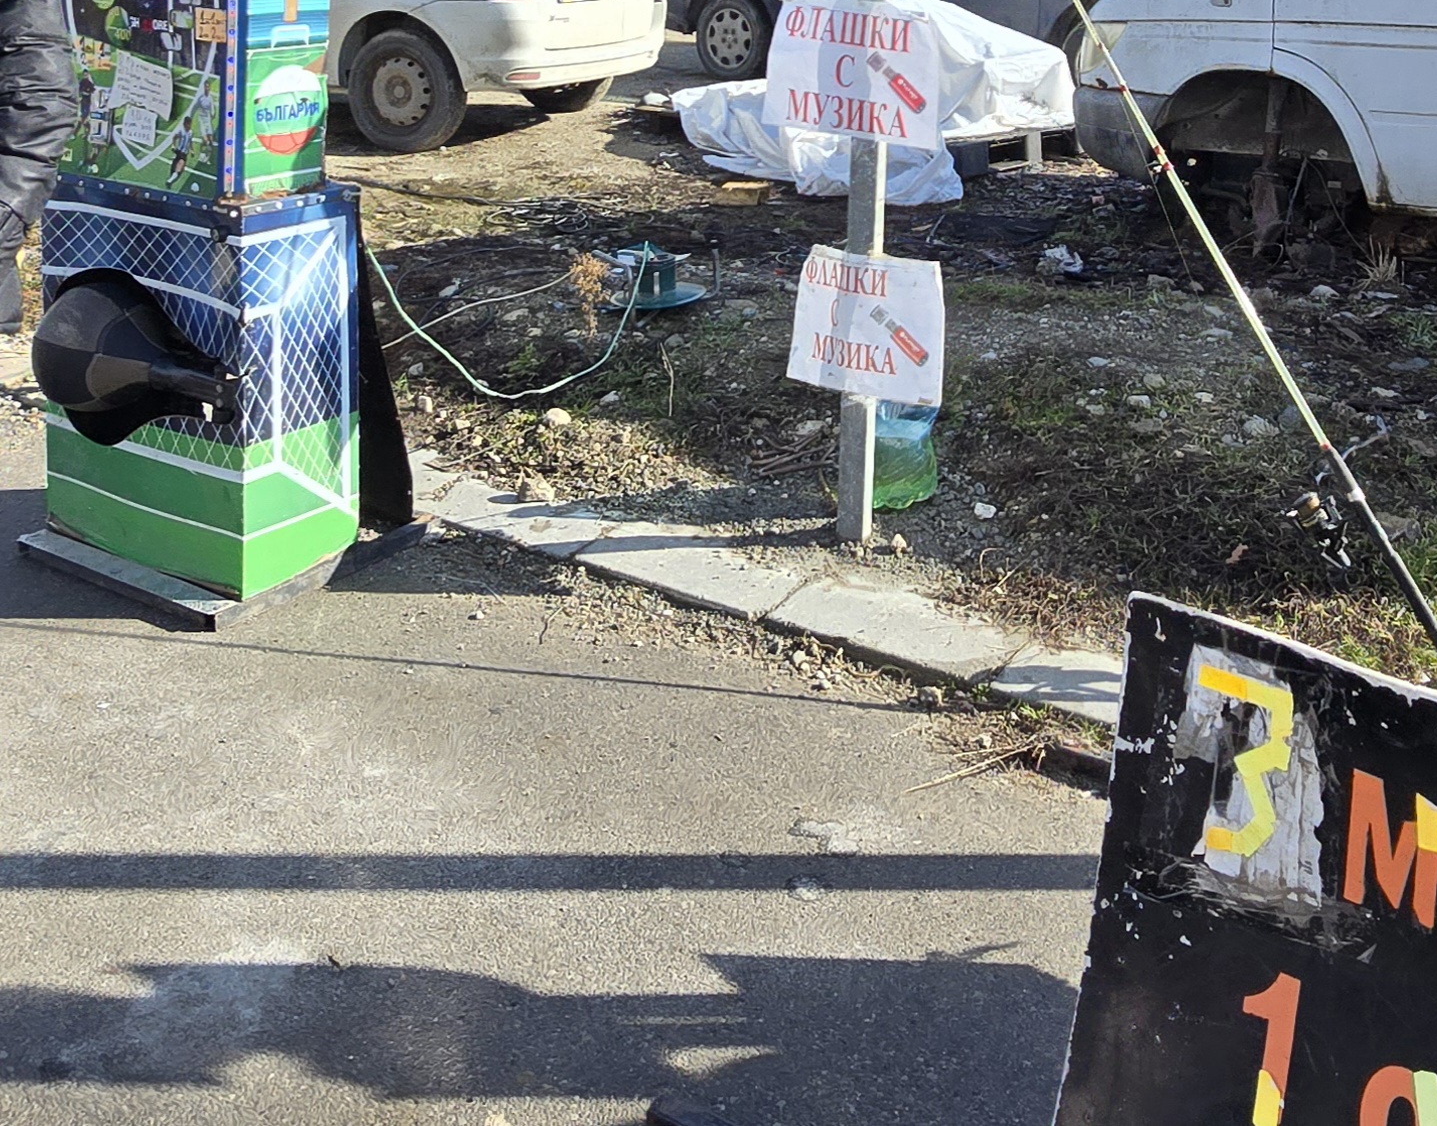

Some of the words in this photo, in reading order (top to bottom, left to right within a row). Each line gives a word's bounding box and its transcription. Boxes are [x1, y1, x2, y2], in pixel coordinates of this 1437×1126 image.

[784, 6, 912, 54] ФЛАШКИ
[834, 54, 856, 88] С
[255, 101, 321, 123] БЪЛГАРИЯ
[785, 88, 909, 140] МУЗИКА
[811, 332, 897, 376] МУЗИКА
[1196, 664, 1293, 858] 3
